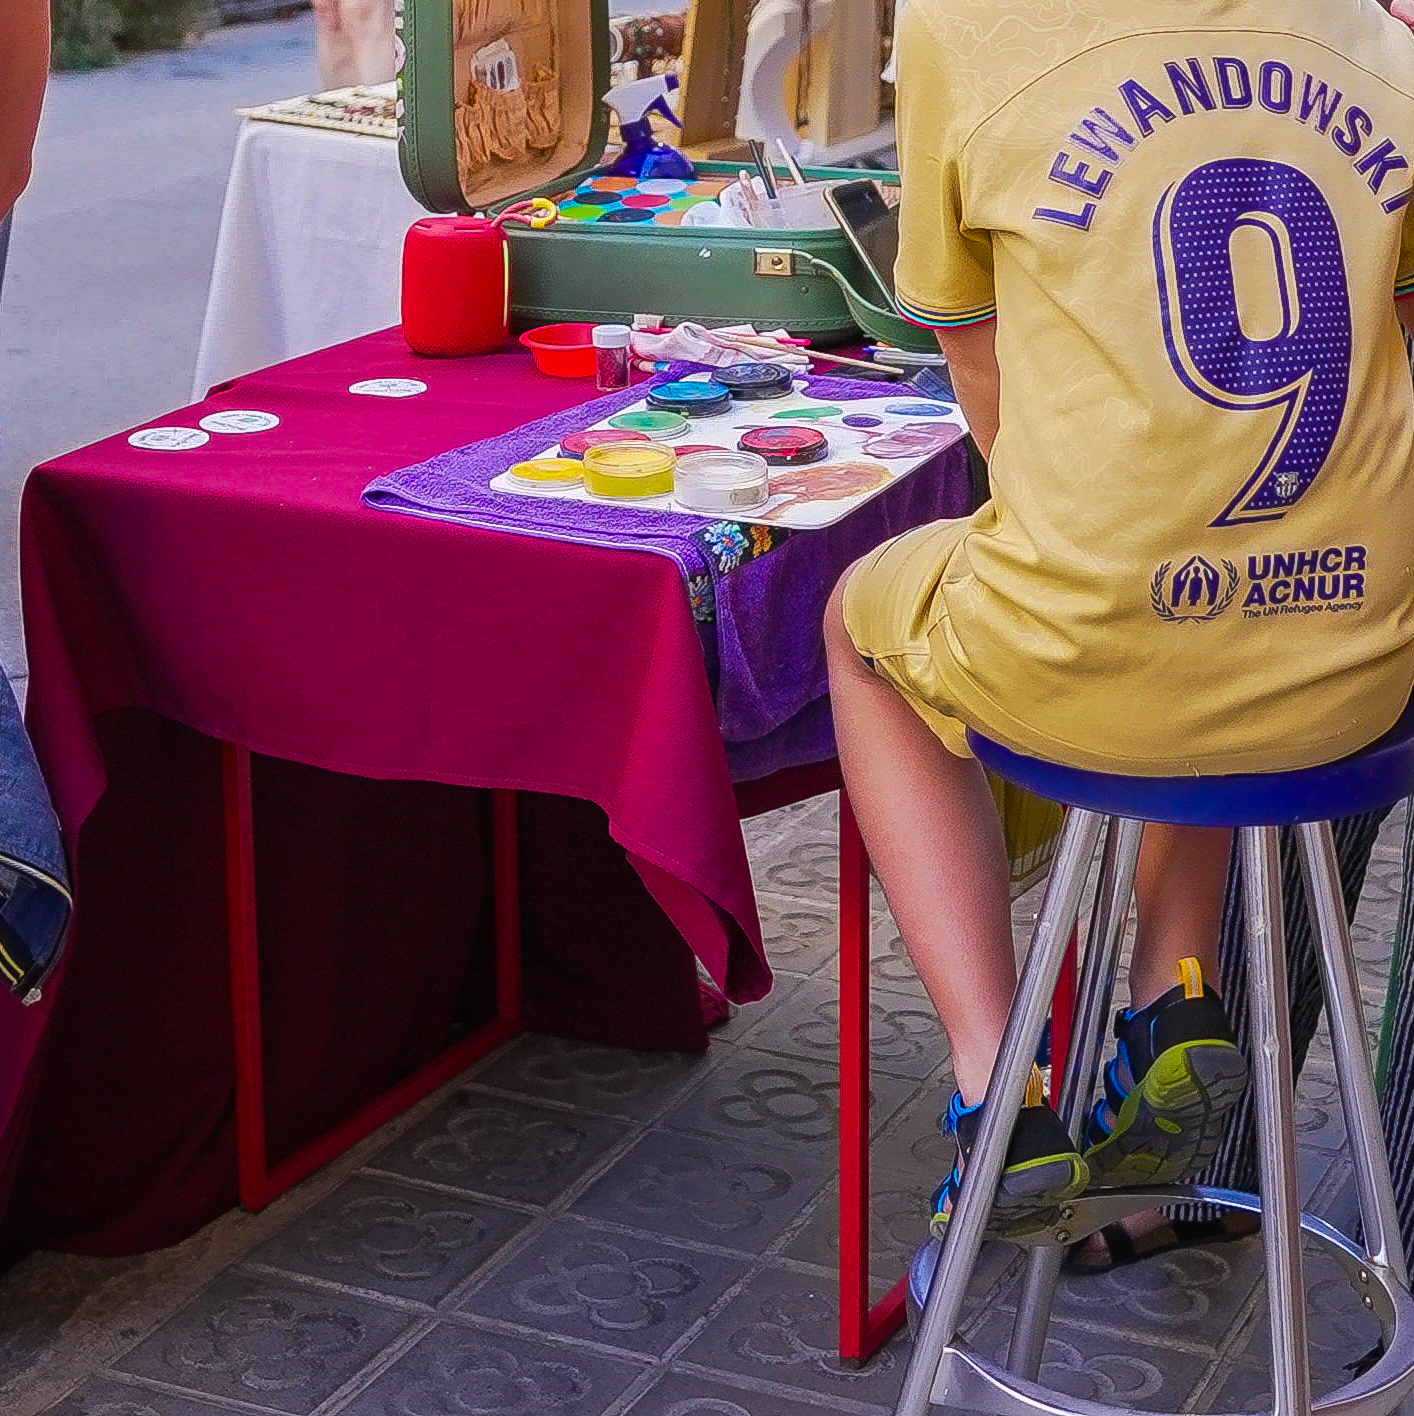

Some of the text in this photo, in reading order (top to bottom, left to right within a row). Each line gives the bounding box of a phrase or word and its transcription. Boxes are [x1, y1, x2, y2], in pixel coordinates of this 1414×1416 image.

[1031, 56, 1413, 232] LEWANDOWSKI
[1152, 156, 1354, 529] 9
[1247, 545, 1367, 581] UNHCR
[1241, 572, 1365, 608] ACNUR
[1242, 601, 1364, 619] The UN Refugee Agency
